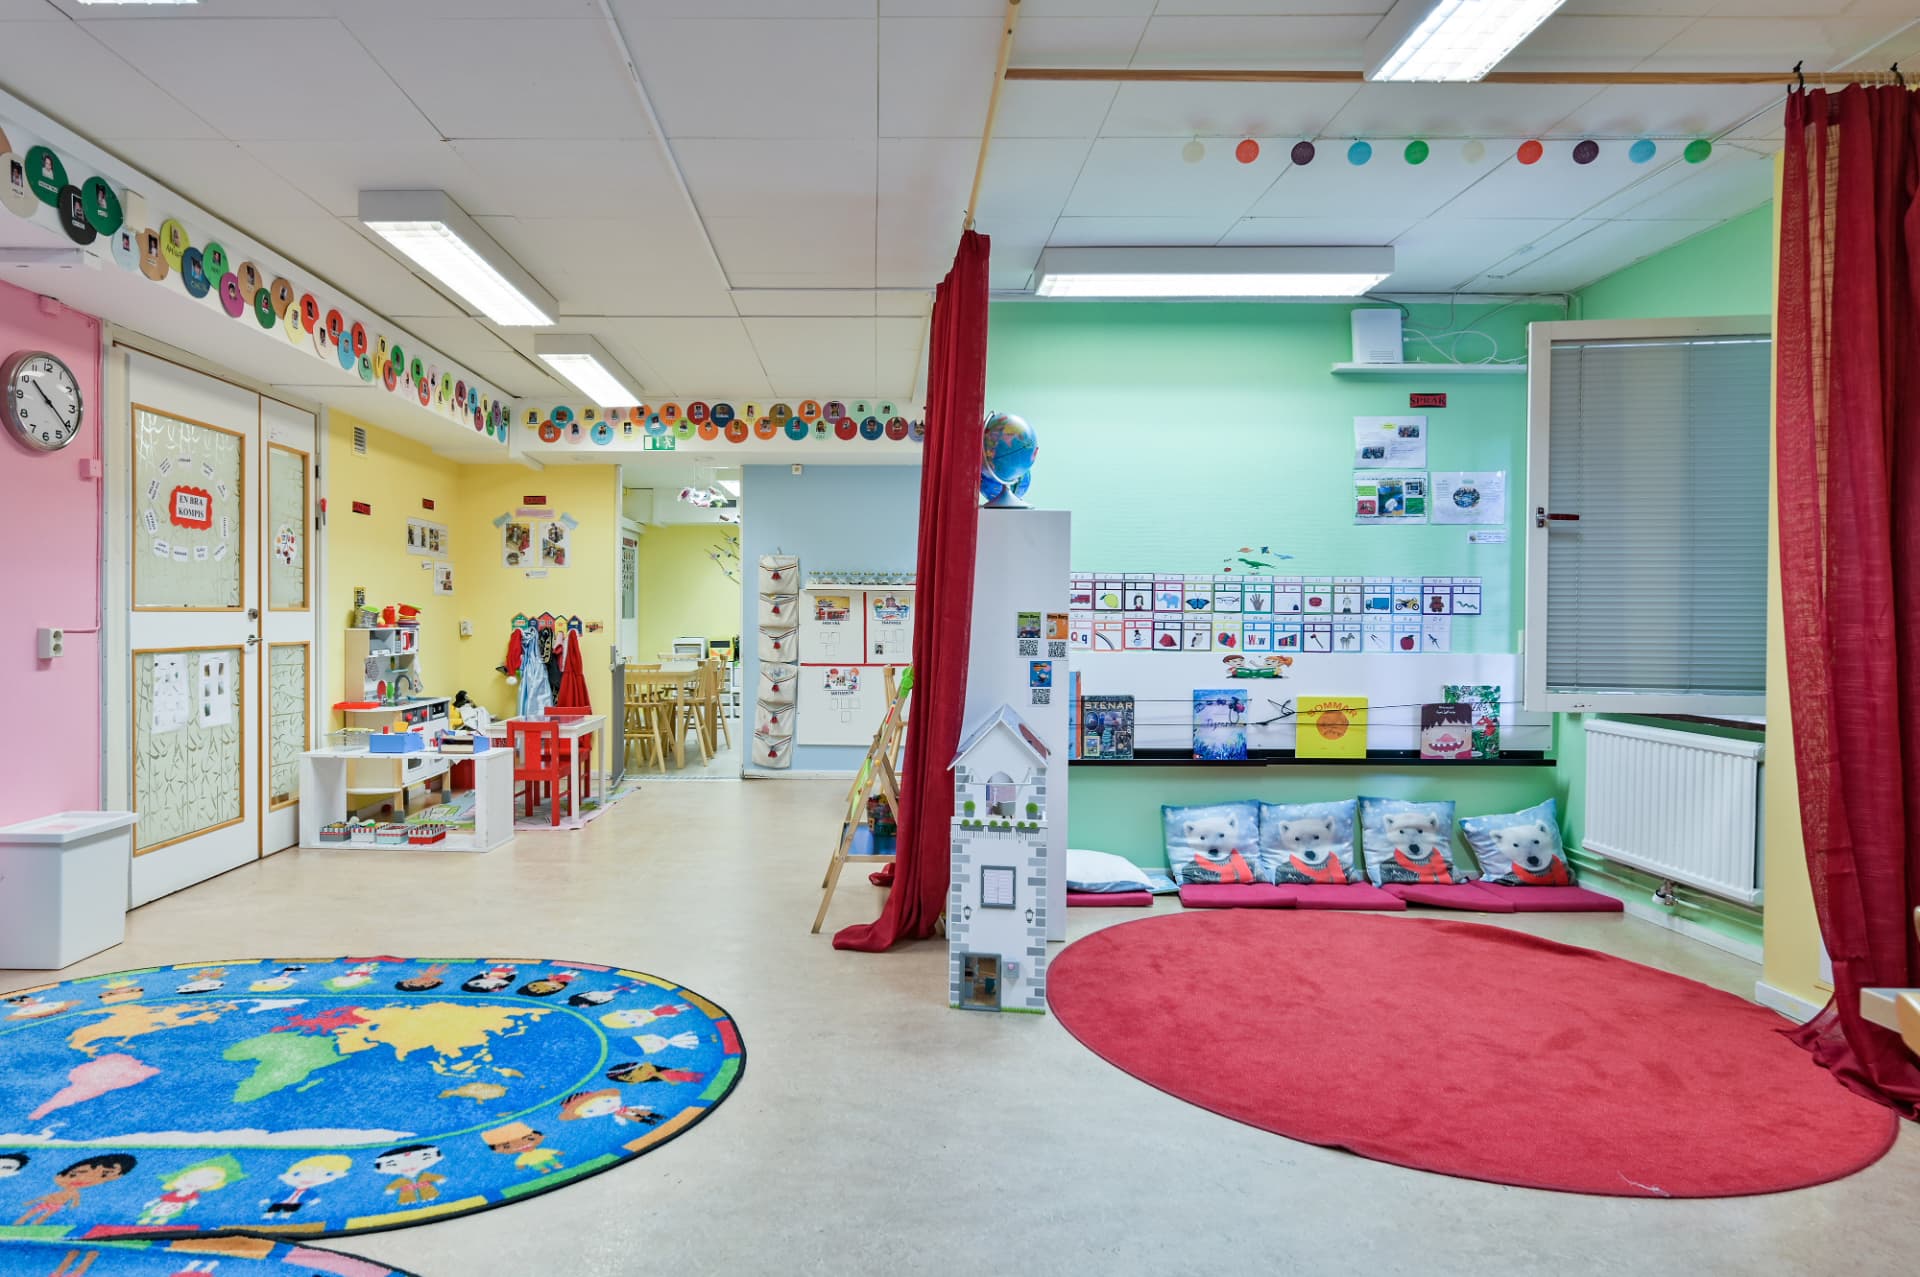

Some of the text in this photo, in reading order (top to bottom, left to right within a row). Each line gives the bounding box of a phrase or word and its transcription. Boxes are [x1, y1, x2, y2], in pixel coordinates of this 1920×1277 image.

[32, 364, 38, 372] 11
[44, 362, 53, 373] 12
[21, 375, 30, 383] 10
[16, 389, 24, 399] 9
[20, 408, 28, 418] 8
[68, 404, 76, 414] 3
[30, 423, 37, 433] 7
[42, 432, 50, 441] 6
[55, 430, 63, 440] 5
[179, 495, 203, 506] EN BRA
[178, 507, 205, 519] KOMPIS
[1084, 701, 1133, 710] STENAR
[1307, 701, 1358, 718] SOMMAR
